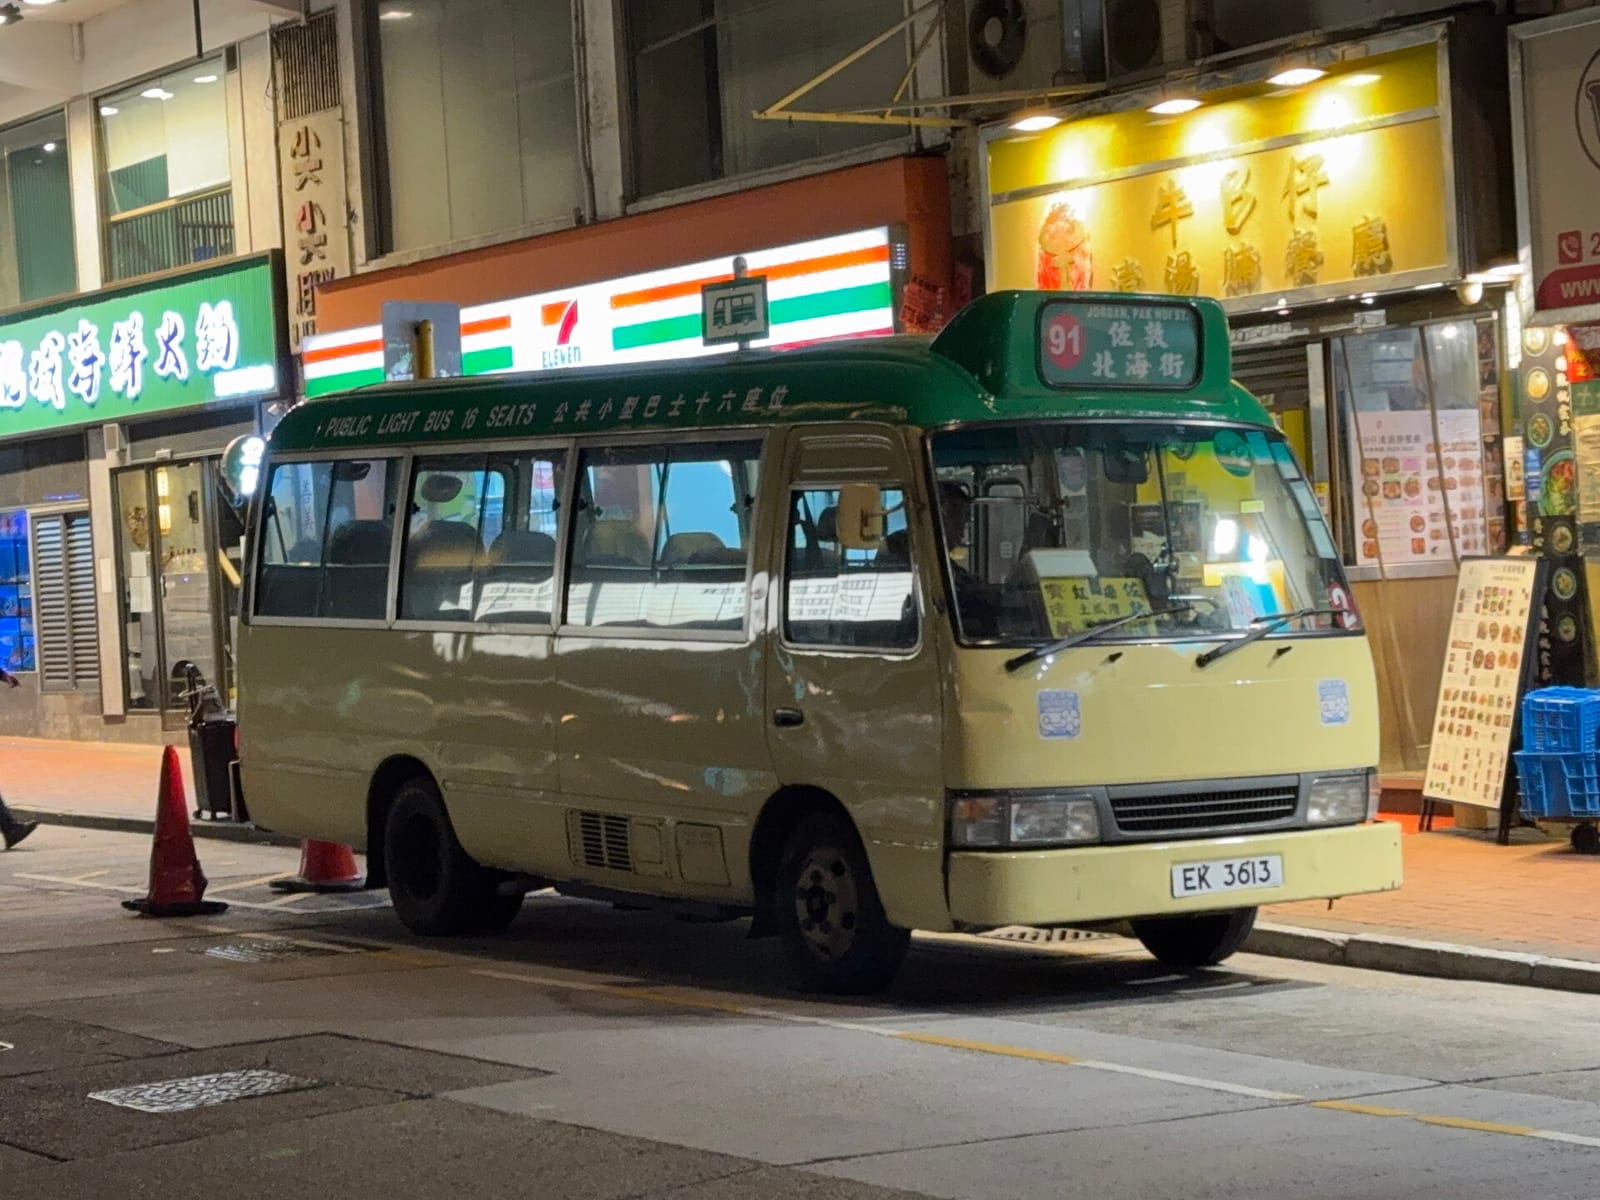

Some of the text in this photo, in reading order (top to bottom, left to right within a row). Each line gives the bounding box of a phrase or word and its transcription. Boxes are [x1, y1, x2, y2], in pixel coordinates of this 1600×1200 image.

[1049, 324, 1080, 355] 91
[1108, 320, 1169, 348] 佐敦
[1092, 350, 1185, 379] 北海街
[324, 384, 789, 437] PUBLIC LIGHT BUS 16 SEATS 公共小型巴士十六座位
[1183, 860, 1271, 891] EK 3613
